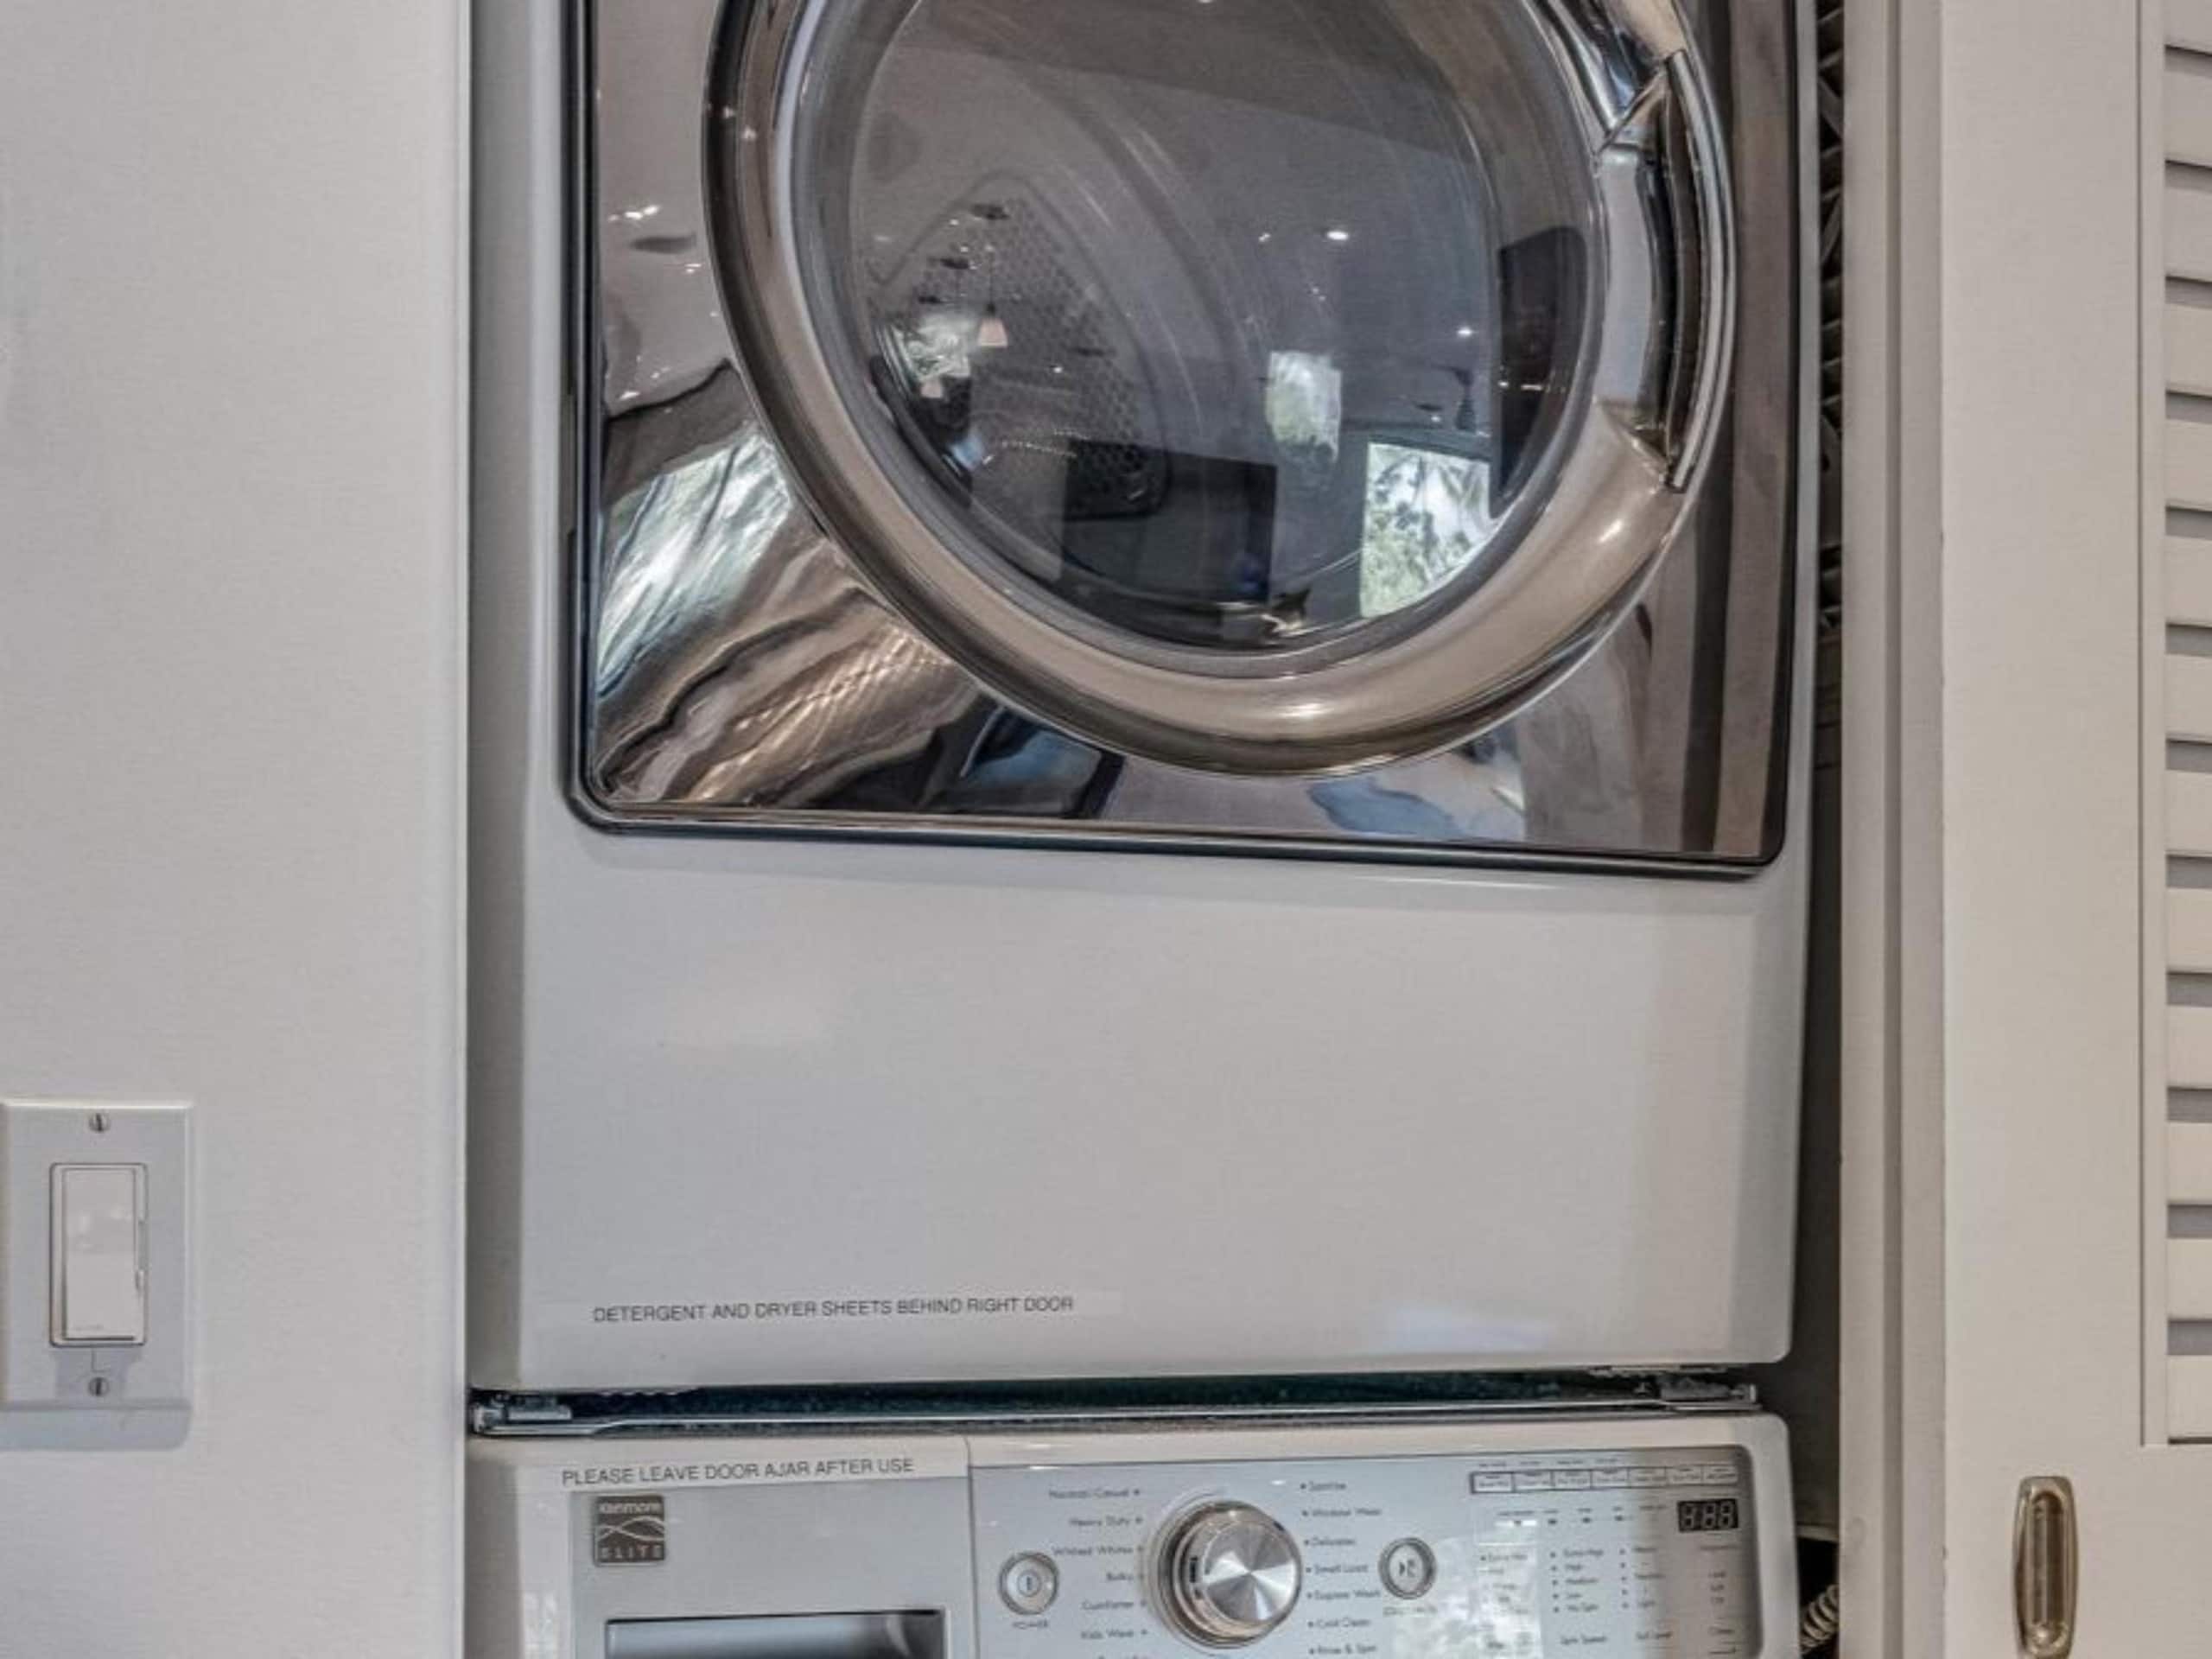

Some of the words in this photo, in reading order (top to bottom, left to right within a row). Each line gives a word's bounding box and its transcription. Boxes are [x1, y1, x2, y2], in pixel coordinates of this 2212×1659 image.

[593, 1305, 706, 1323] DETERGENT
[712, 1302, 751, 1319] AND
[754, 1300, 817, 1319] DRYER
[821, 1300, 893, 1317] SHEETS
[897, 1298, 963, 1314] BEHIND
[966, 1297, 1021, 1313] RIGHT
[1024, 1296, 1073, 1313] DOOR
[563, 1467, 635, 1486] PLEASE
[639, 1465, 700, 1482] LEAVE
[705, 1463, 760, 1480] DOOR
[765, 1460, 810, 1478] AJAR
[815, 1459, 873, 1475] AFTER
[878, 1457, 914, 1473] USE
